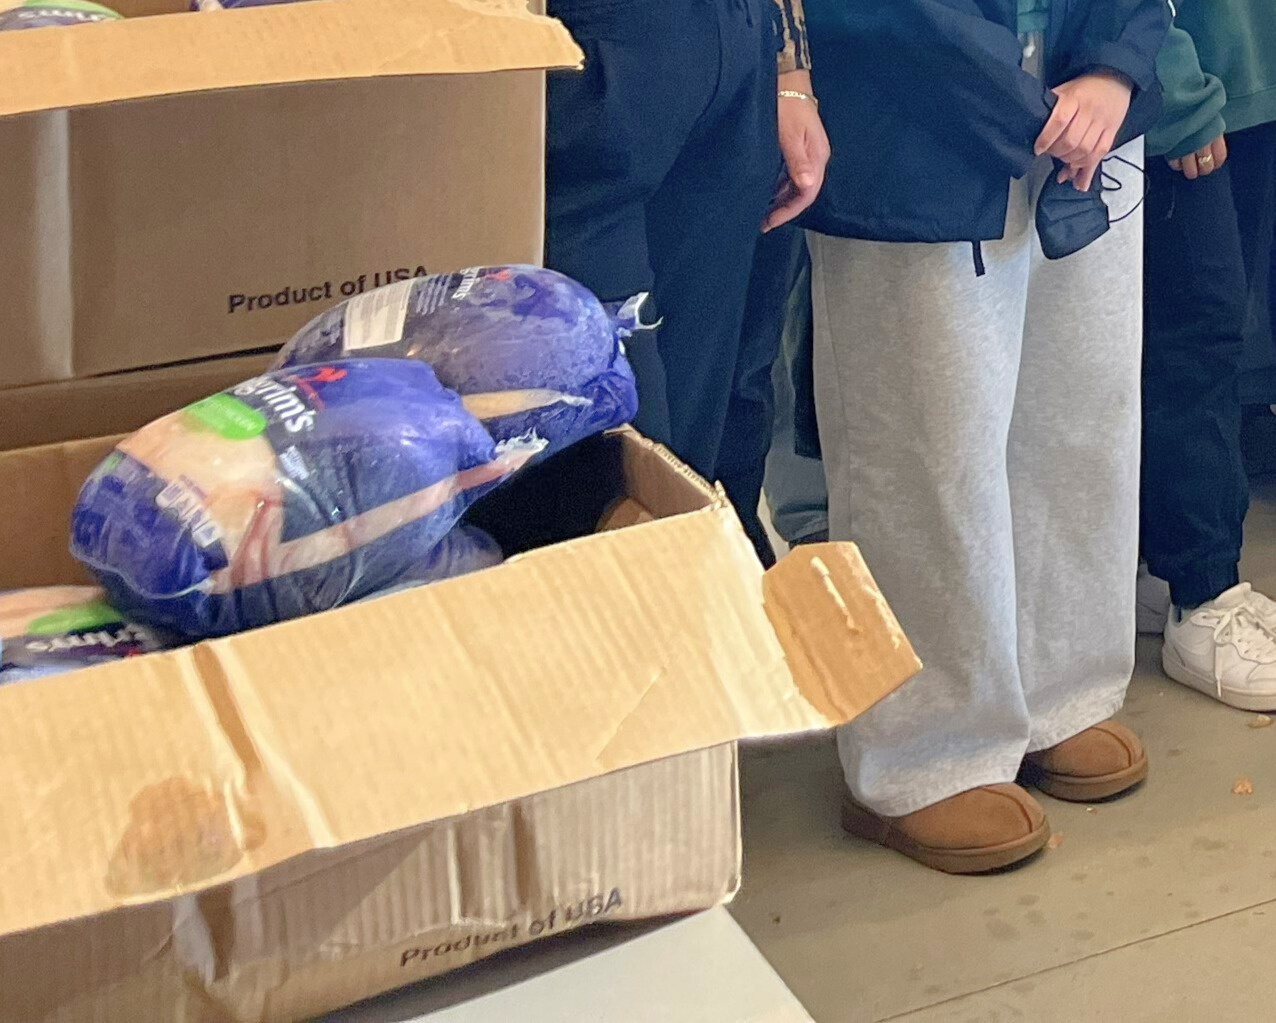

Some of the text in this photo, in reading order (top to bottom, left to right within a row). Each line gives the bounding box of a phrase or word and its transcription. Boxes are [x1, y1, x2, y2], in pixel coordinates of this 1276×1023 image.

[227, 286, 332, 314] Product
[340, 274, 367, 296] of
[401, 887, 623, 967] Product of USA
